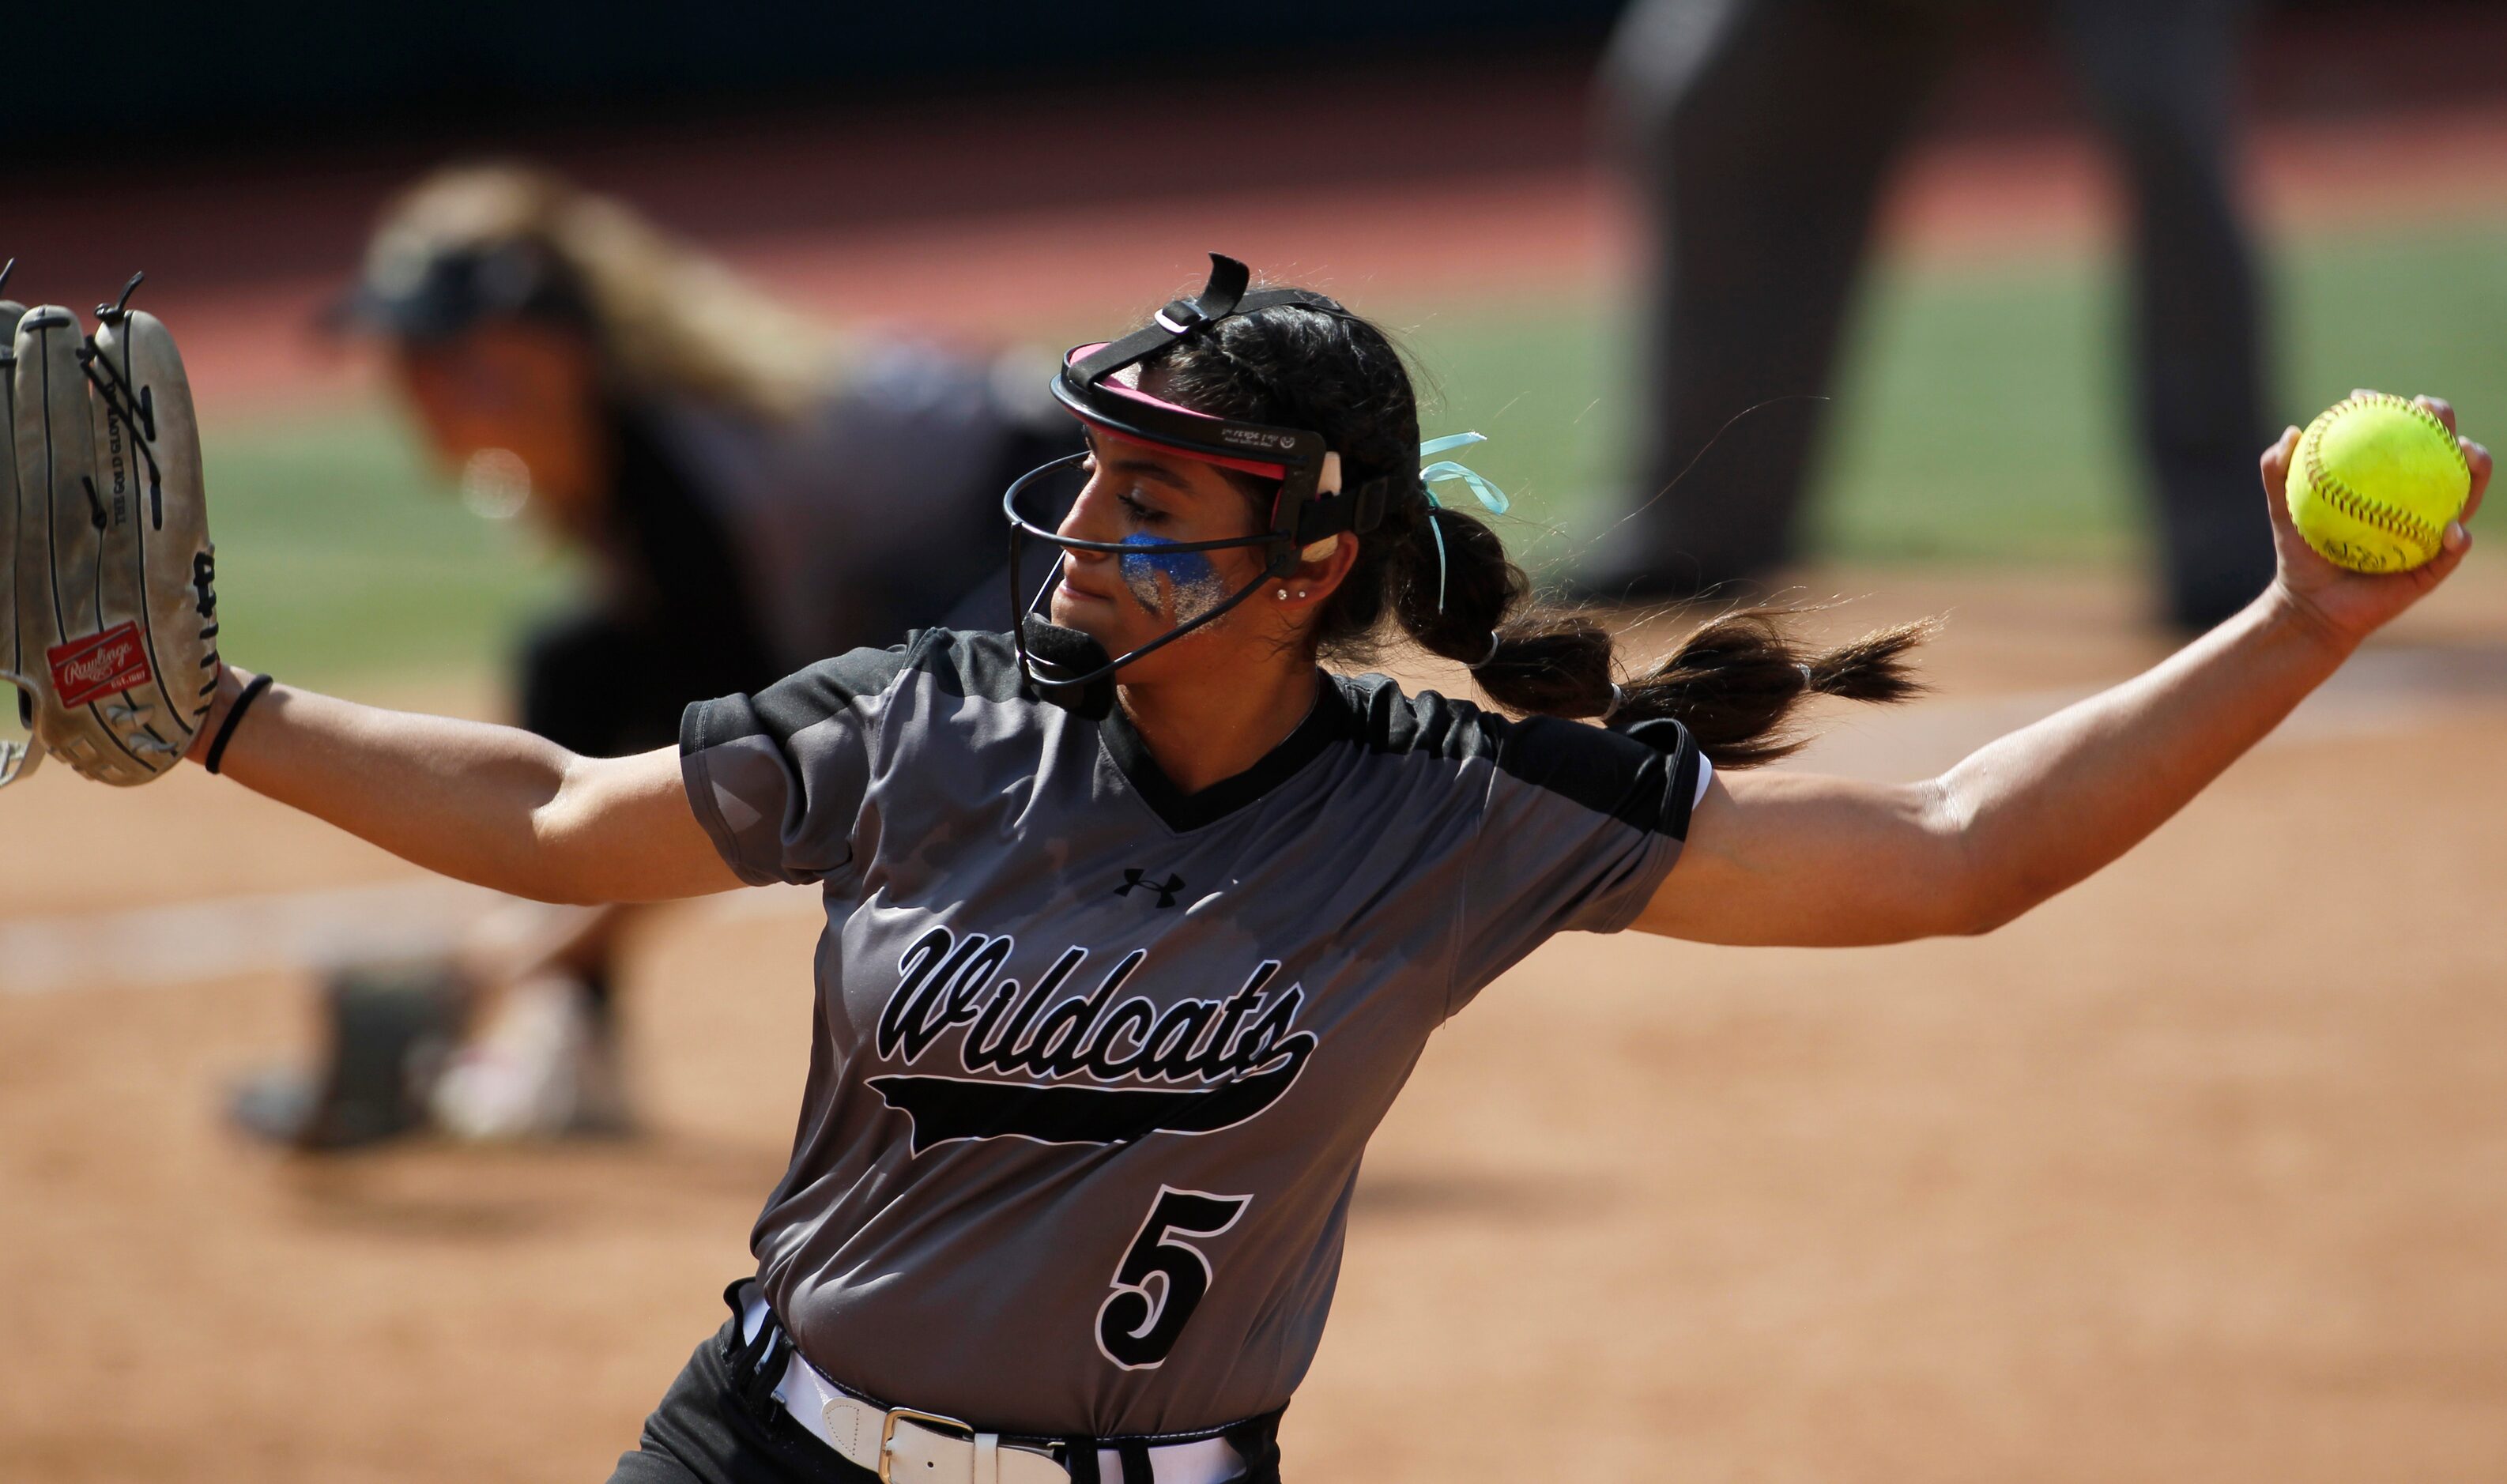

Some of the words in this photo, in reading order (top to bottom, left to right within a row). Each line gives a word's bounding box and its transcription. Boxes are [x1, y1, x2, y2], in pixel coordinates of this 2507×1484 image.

[112, 457, 126, 495] GOLD
[64, 643, 133, 686] Rawlings
[877, 925, 1314, 1083] Wildcats
[1095, 1184, 1254, 1371] 5
